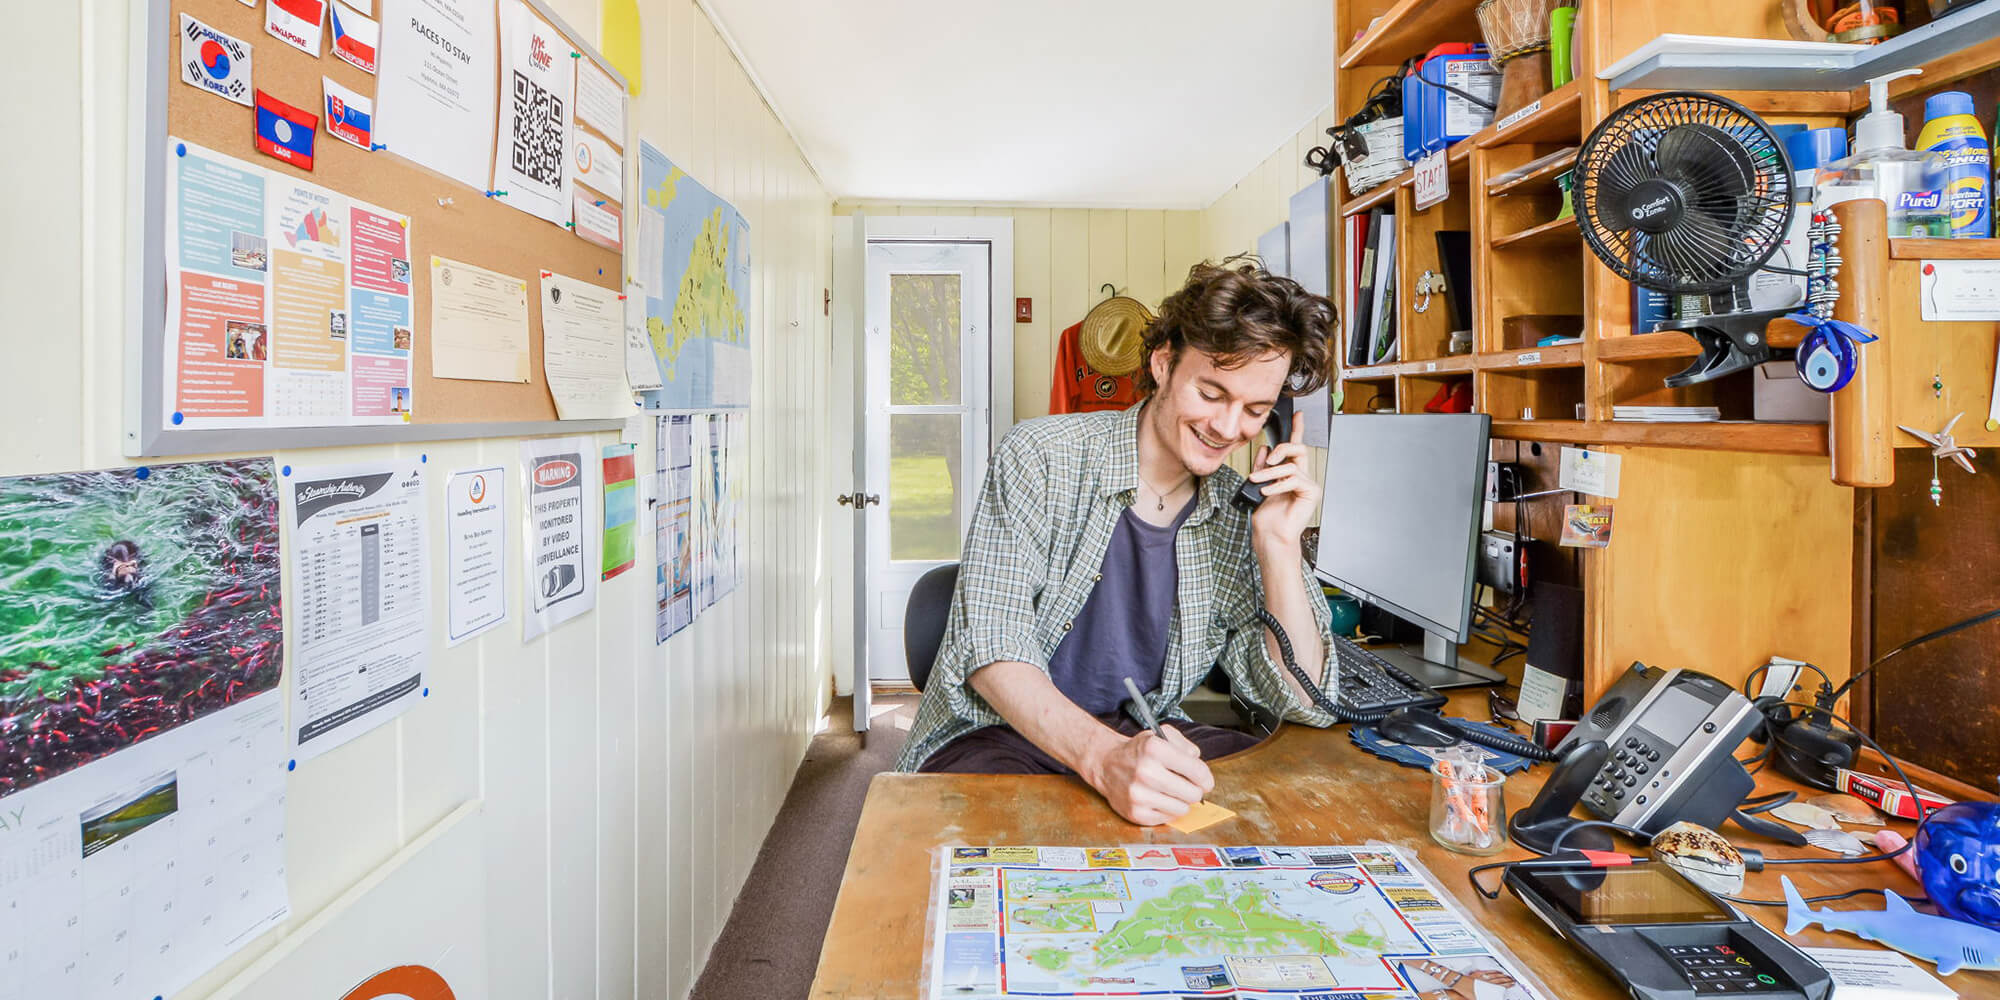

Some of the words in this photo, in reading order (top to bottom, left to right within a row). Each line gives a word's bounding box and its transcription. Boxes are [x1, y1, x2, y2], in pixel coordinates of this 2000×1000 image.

[203, 29, 229, 46] SOUTH
[270, 22, 307, 47] SINGAPORE
[411, 17, 440, 45] PLACES
[441, 37, 451, 52] TO
[453, 46, 471, 65] STAY
[203, 77, 230, 96] KOREA
[335, 126, 359, 143] SLOVAKIA
[274, 144, 291, 158] LAOS
[1641, 196, 1670, 210] Comfort
[1900, 193, 1939, 208] Purell
[538, 465, 571, 482] WARNING
[306, 483, 337, 499] Steamship
[336, 480, 366, 498] Authority
[534, 504, 547, 514] THIS
[548, 496, 579, 512] PROPERTY
[540, 514, 573, 531] MONITORED
[543, 537, 550, 547] BY
[552, 531, 570, 544] VIDEO
[536, 545, 579, 567] SURVEILLANCE
[1328, 992, 1362, 1000] DUNES
